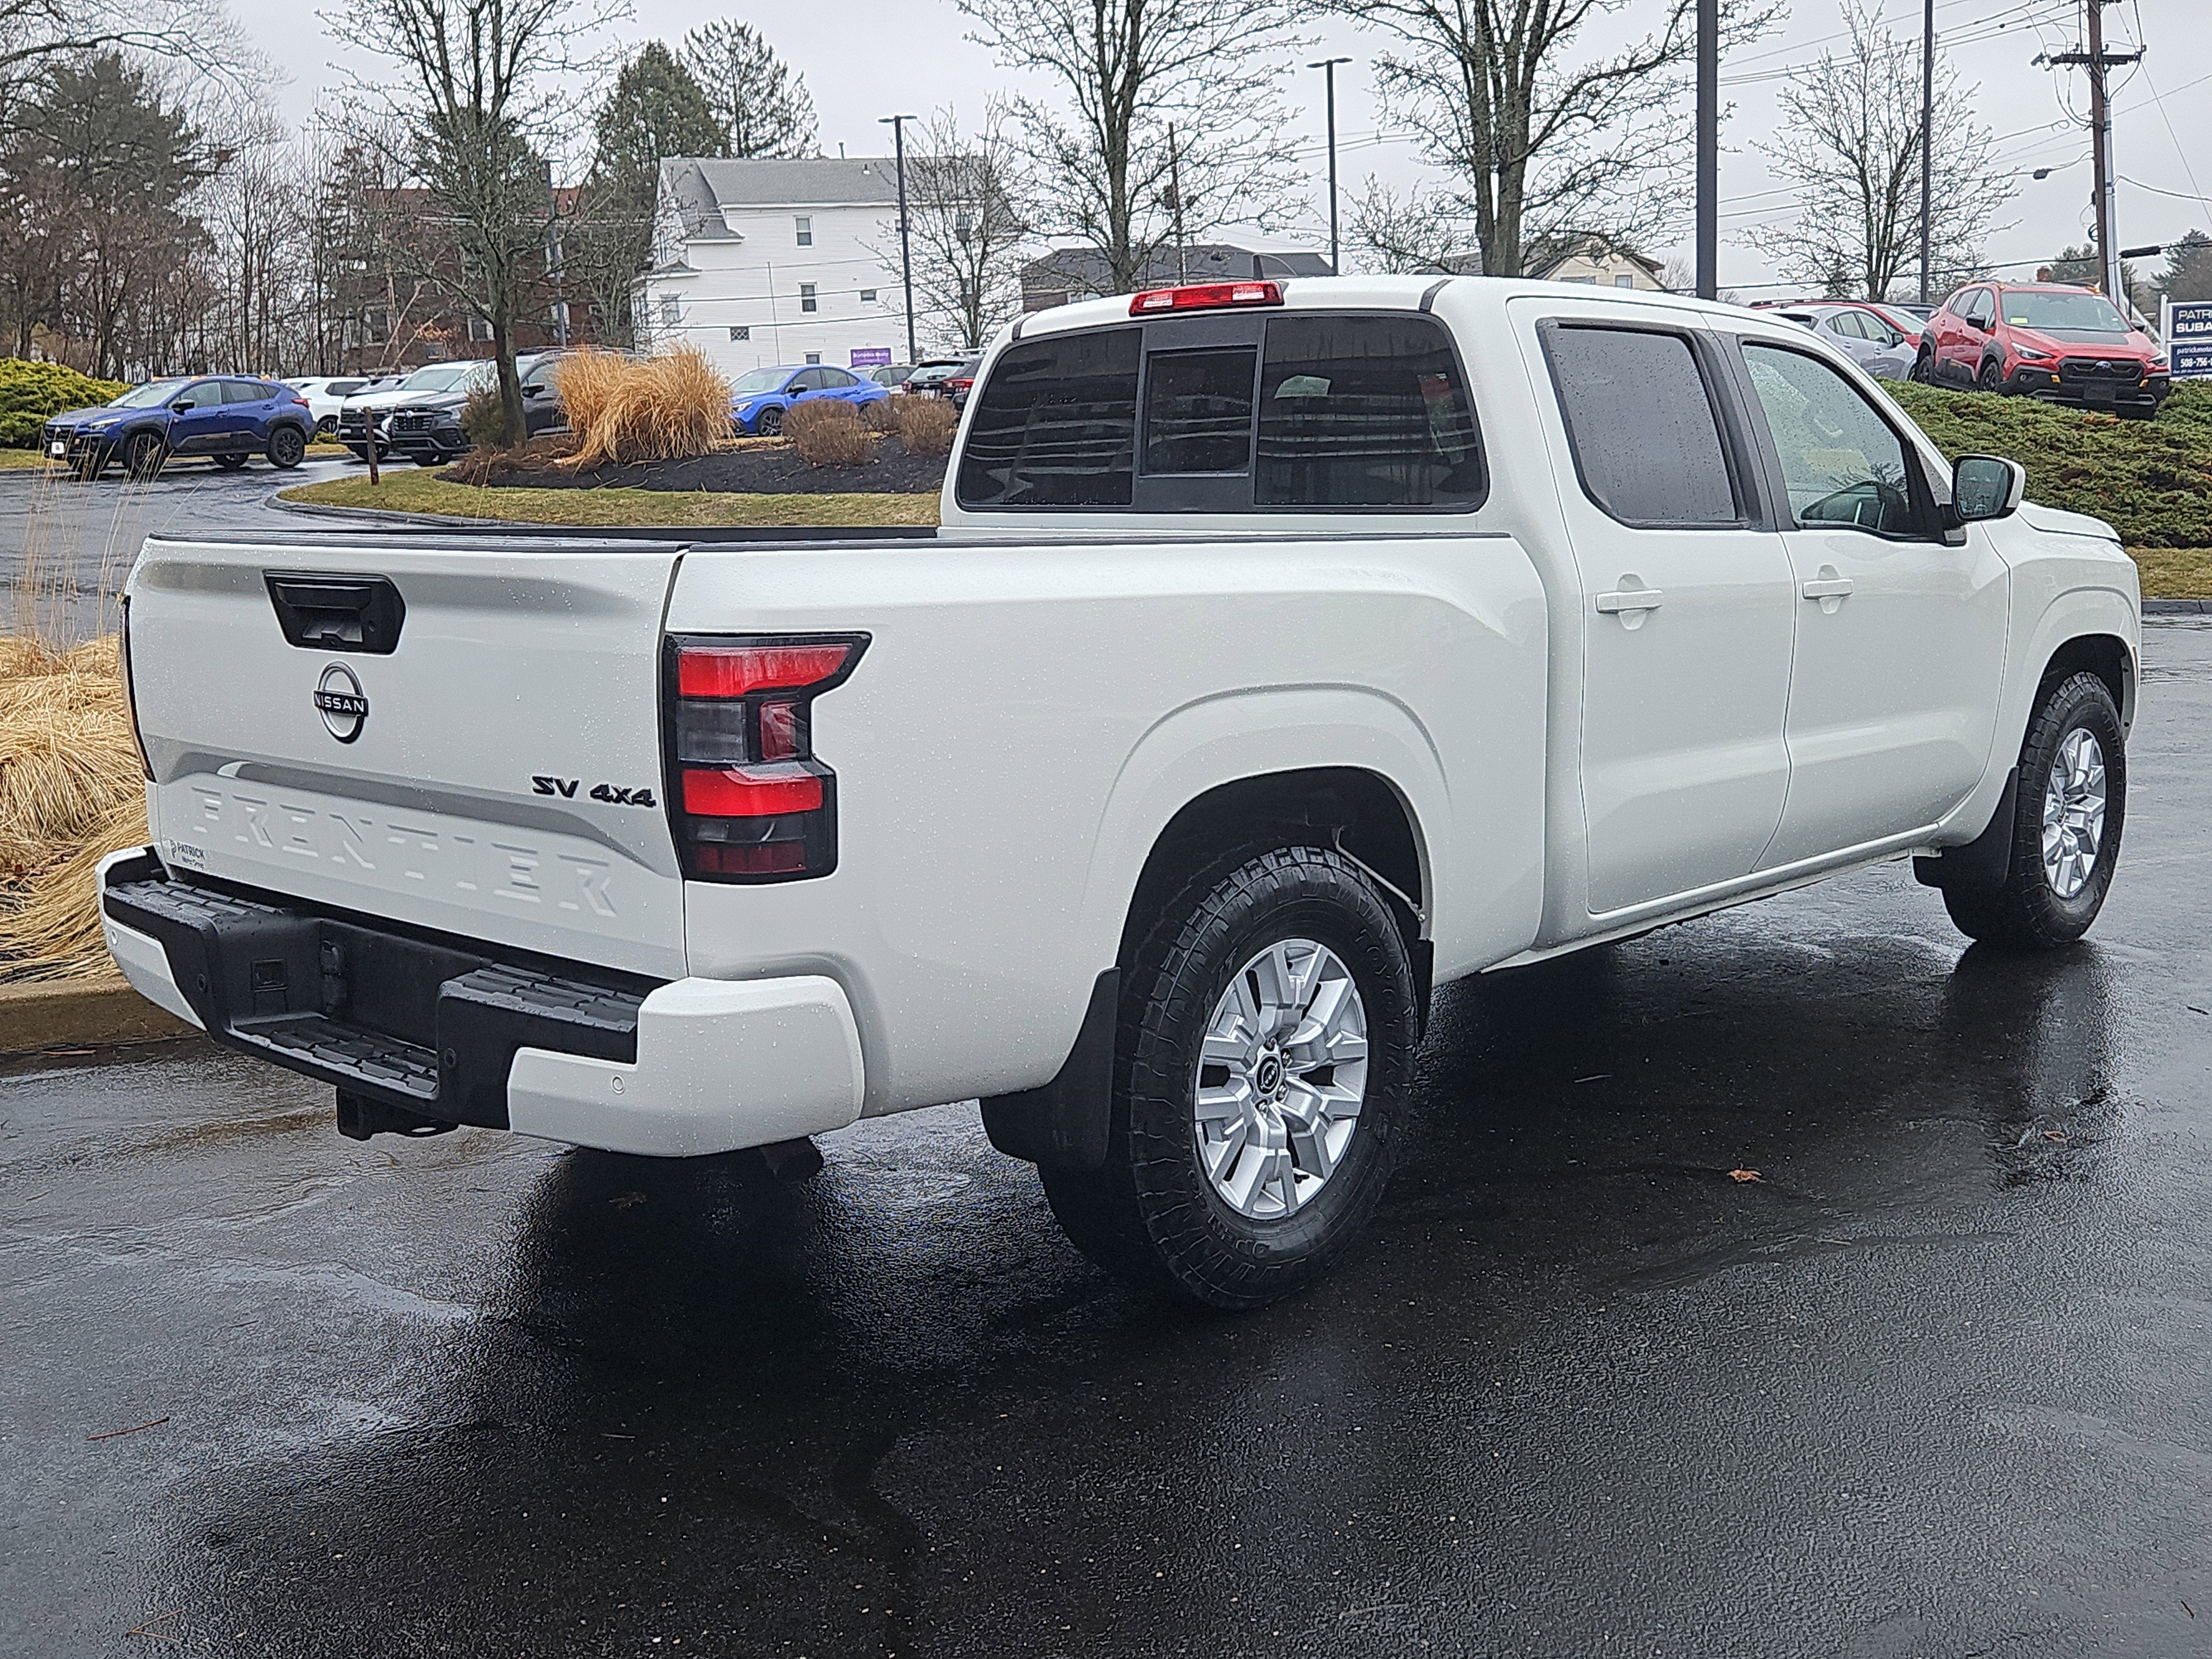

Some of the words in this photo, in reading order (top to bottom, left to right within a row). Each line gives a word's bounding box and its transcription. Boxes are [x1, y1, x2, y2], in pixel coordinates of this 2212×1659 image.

[314, 693, 364, 712] NISSAN
[532, 776, 579, 798] SV
[177, 841, 205, 861] PATRICK
[191, 787, 617, 917] FRONTIER
